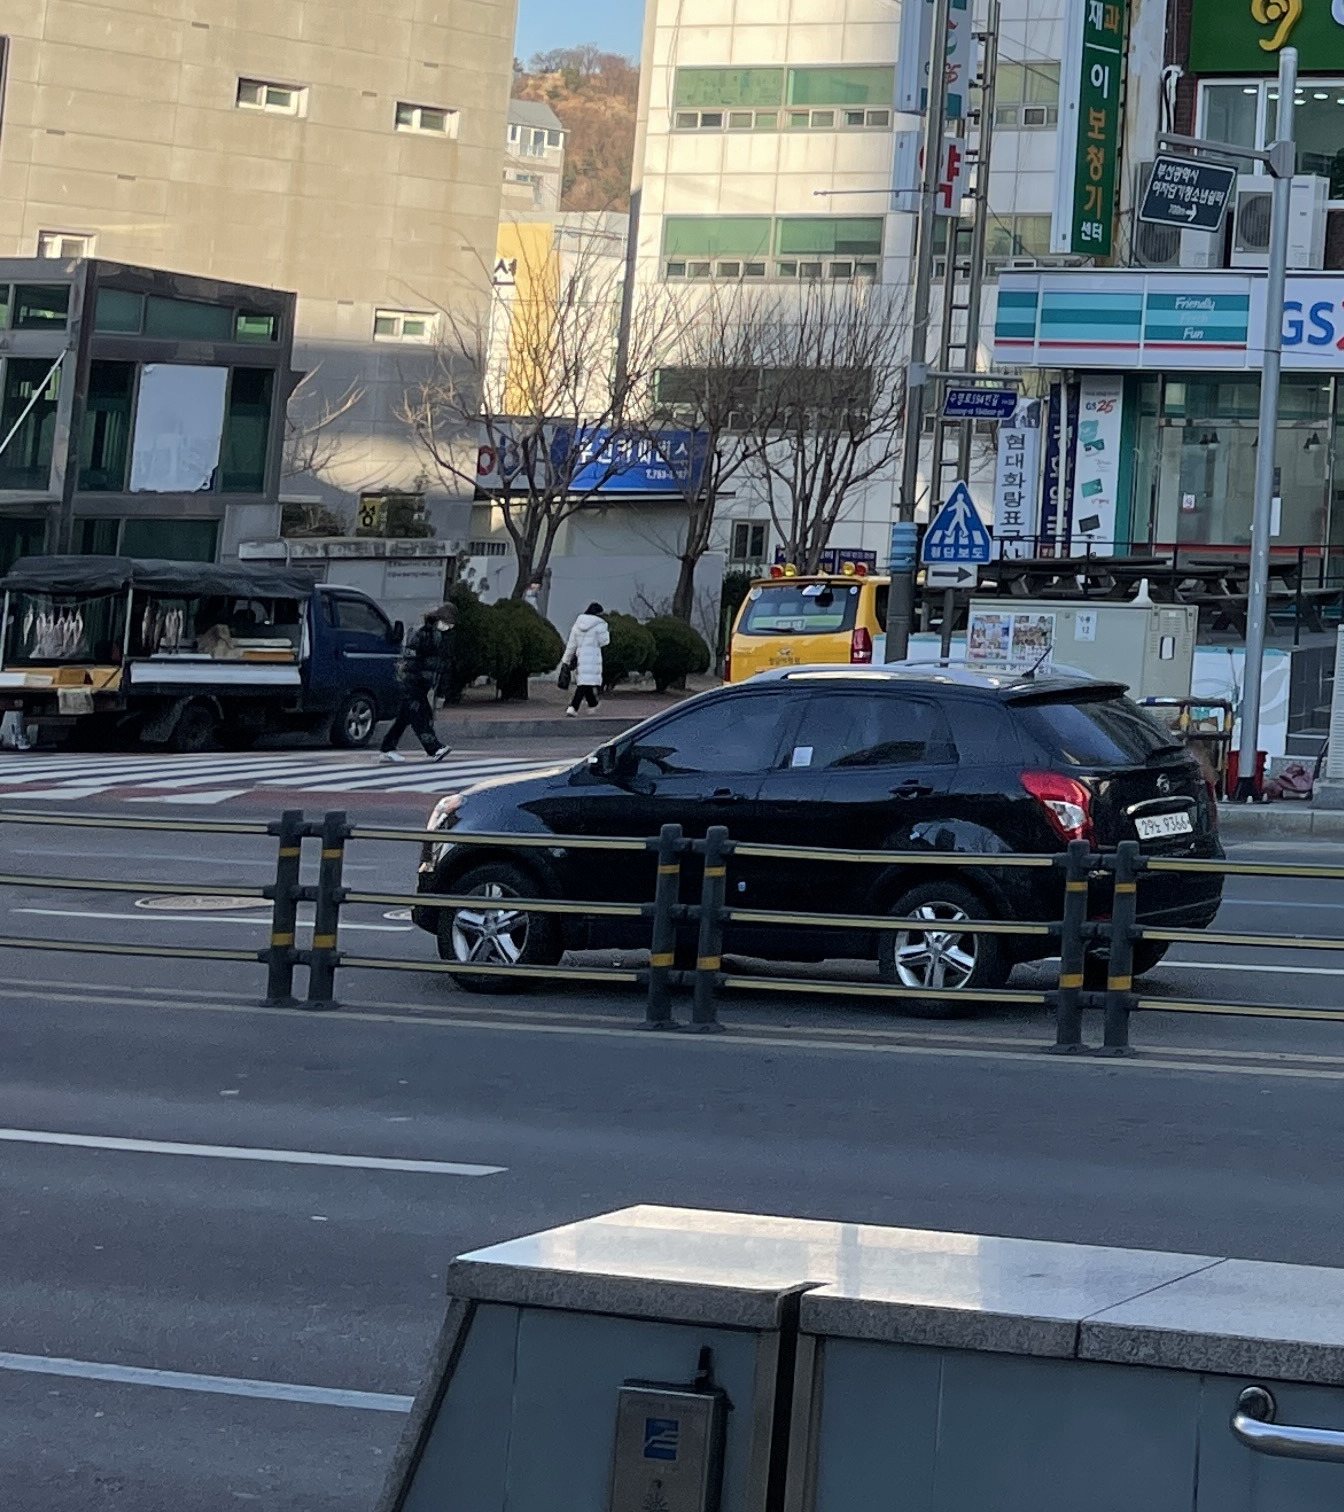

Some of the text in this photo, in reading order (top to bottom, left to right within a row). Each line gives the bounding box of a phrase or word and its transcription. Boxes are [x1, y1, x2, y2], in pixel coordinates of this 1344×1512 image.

[1080, 63, 1110, 243] 이 보청기 센터
[1174, 295, 1217, 312] Friendly
[1182, 326, 1205, 341] Fun
[930, 545, 985, 559] 횡단보도
